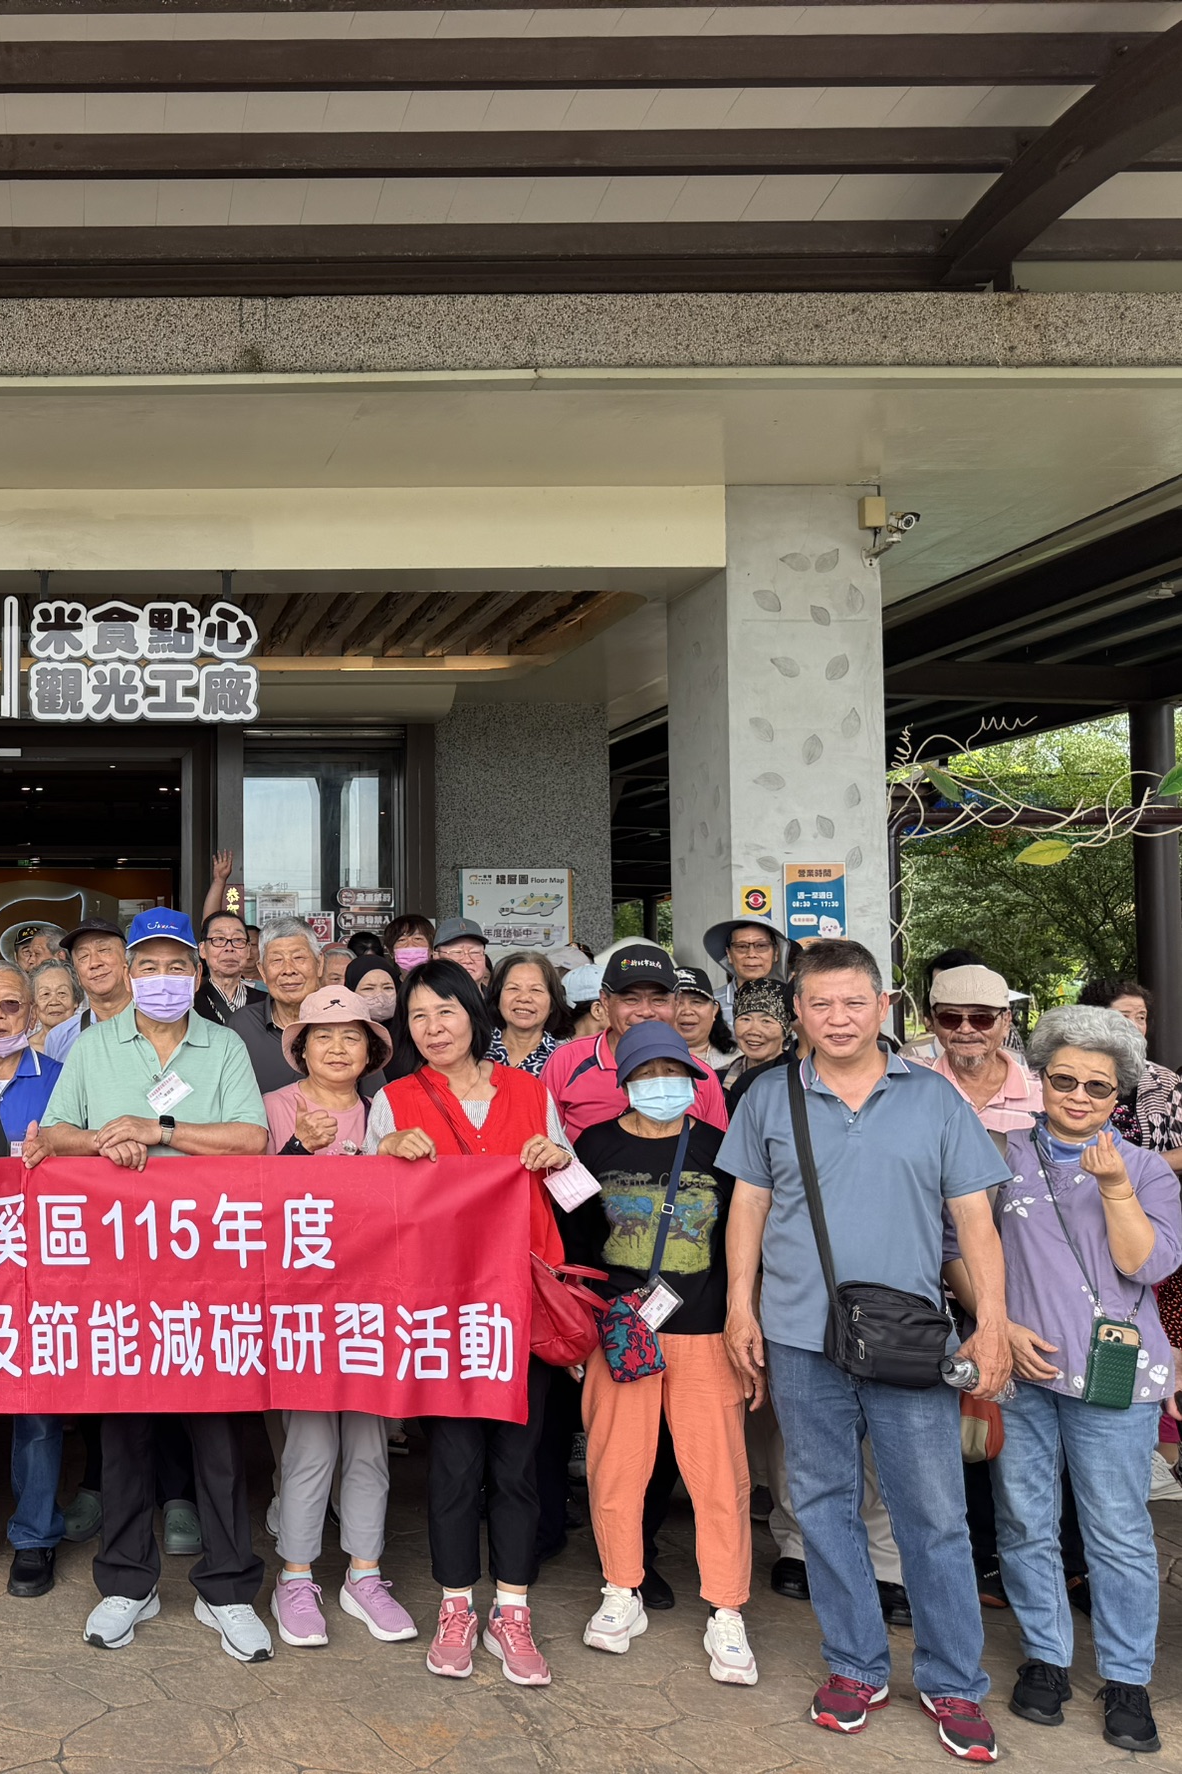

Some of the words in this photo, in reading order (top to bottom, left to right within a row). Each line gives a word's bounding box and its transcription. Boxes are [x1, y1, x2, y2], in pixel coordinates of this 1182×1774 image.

[32, 604, 254, 659] 米食點心
[31, 665, 256, 718] 觀光工廠
[549, 877, 565, 885] Map
